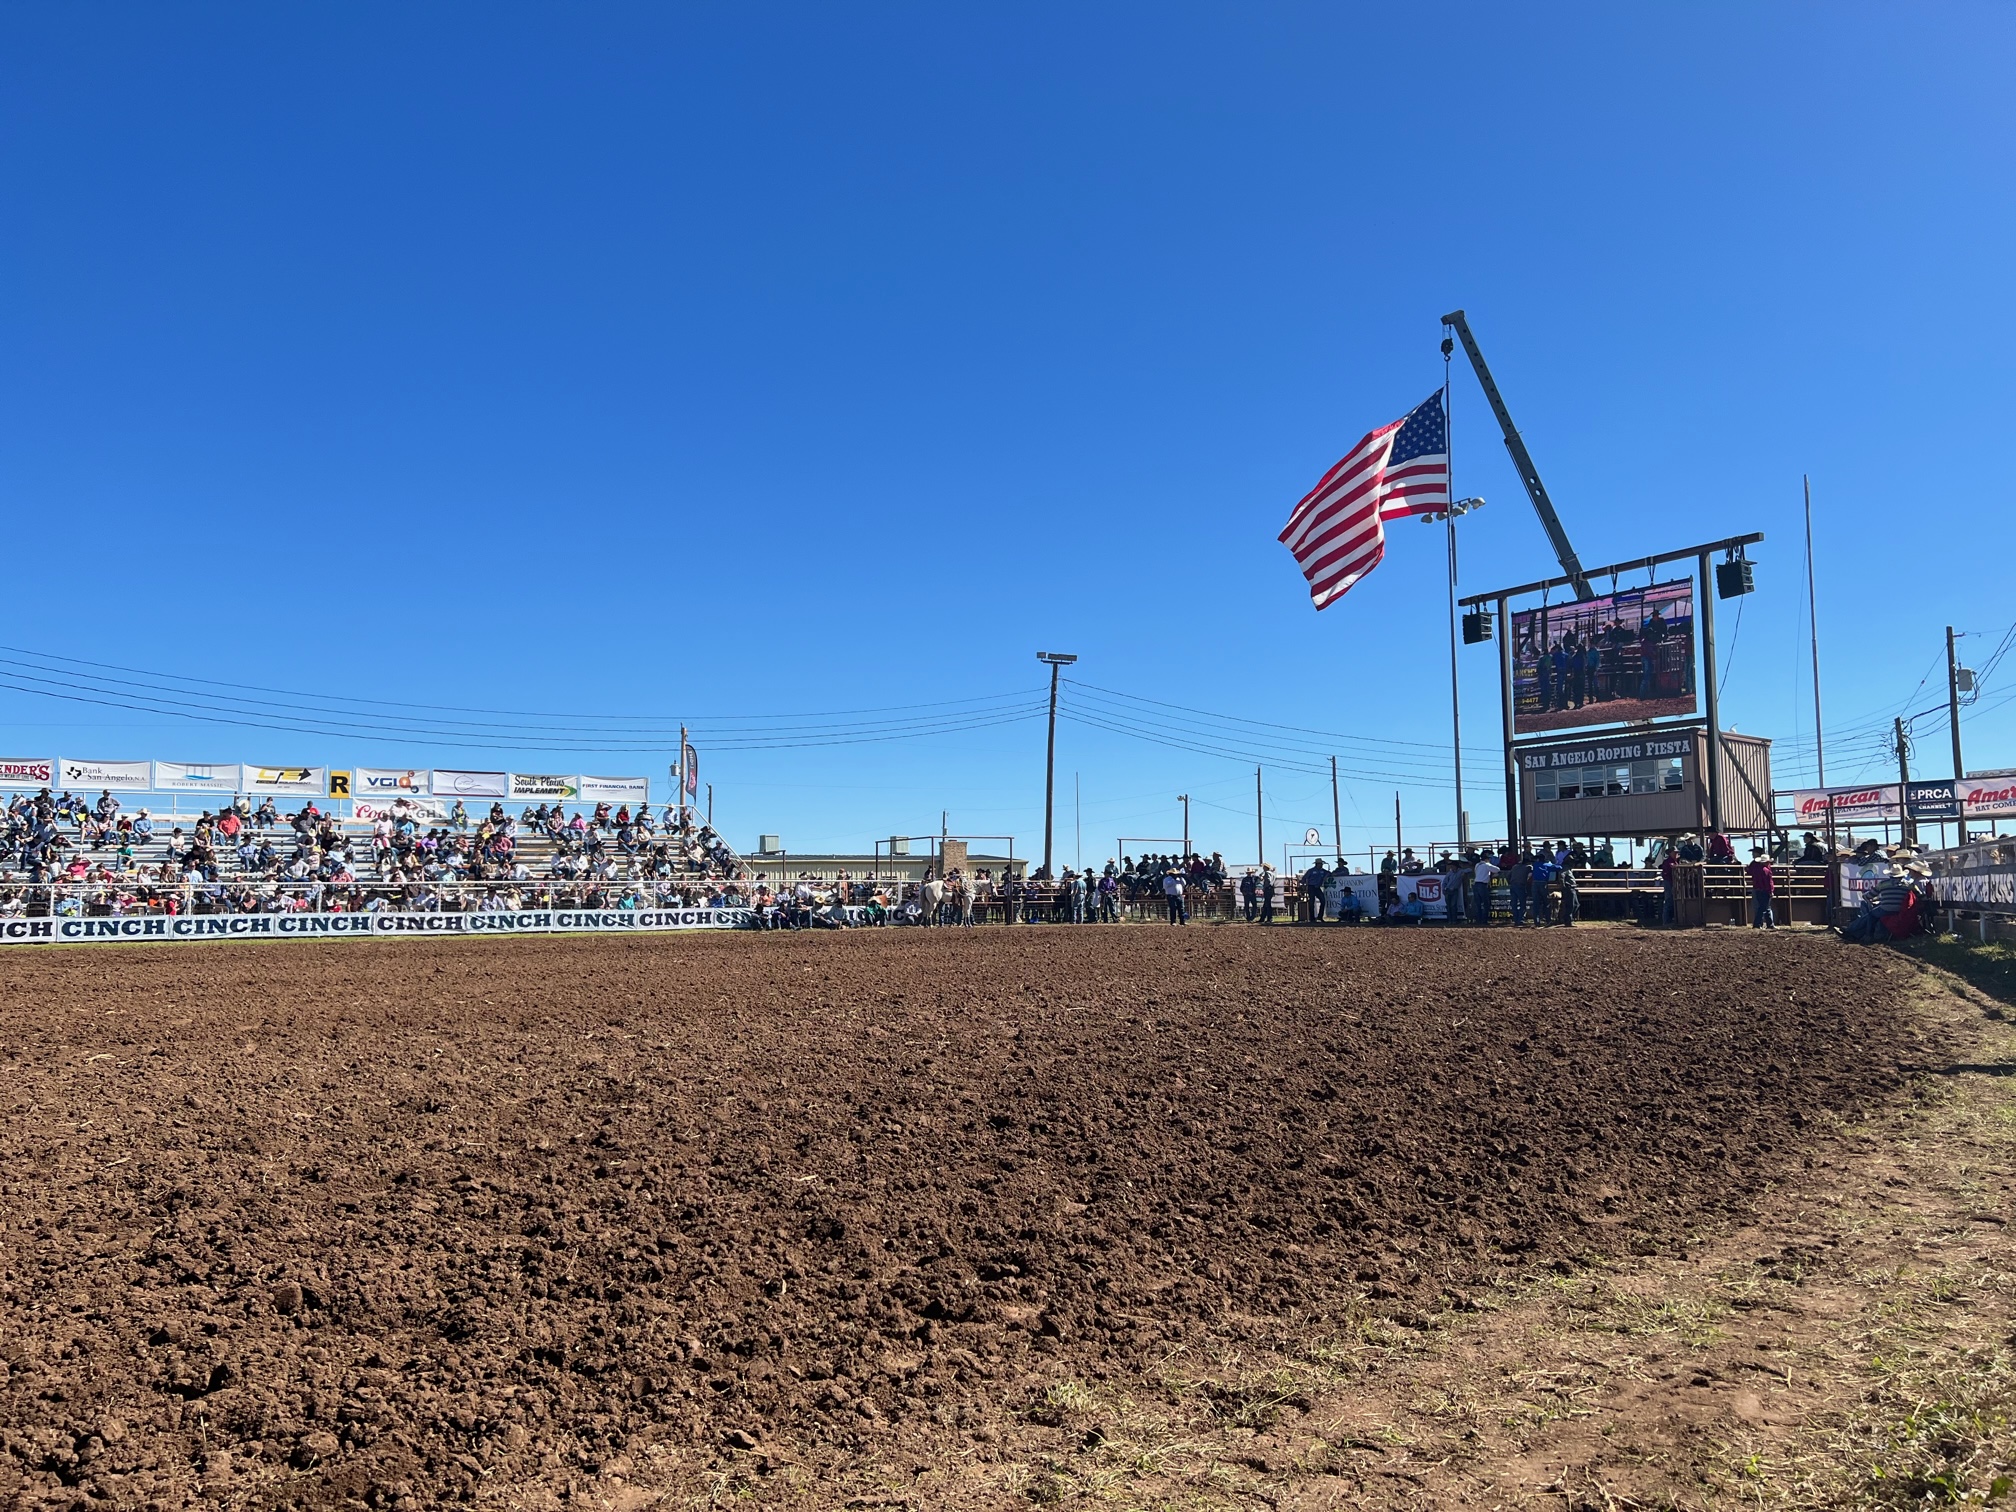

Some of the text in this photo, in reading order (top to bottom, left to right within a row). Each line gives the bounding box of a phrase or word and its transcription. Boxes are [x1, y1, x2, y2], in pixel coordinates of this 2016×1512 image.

[1524, 740, 1691, 769] SAN ANGELO ROPING FIESTA
[331, 775, 348, 793] R
[367, 777, 397, 787] VGI
[514, 775, 565, 787] South Plains
[514, 787, 566, 795] IMPLEMENT
[1917, 788, 1953, 799] PRCA
[1975, 804, 1991, 812] HAT
[1338, 879, 1364, 887] SHANNON
[1418, 885, 1439, 899] HLS
[278, 916, 370, 932] CINCH
[377, 916, 463, 930] CINCH
[470, 913, 552, 929] CINCH
[557, 912, 635, 927] CINCH
[639, 911, 712, 925] CINCH
[0, 922, 53, 938] CH
[61, 919, 166, 937] CINCH
[173, 917, 271, 934] CINCH
